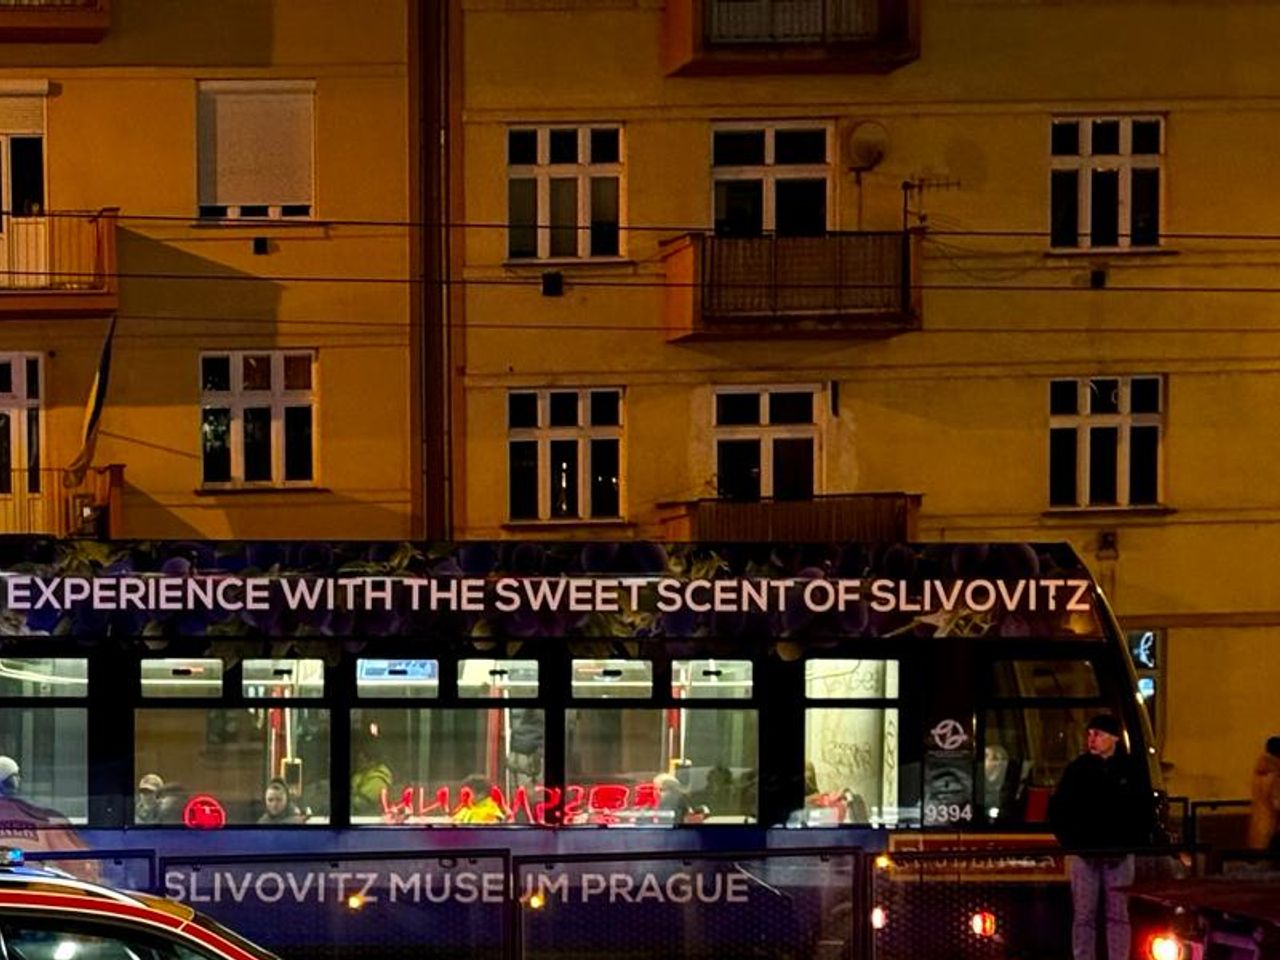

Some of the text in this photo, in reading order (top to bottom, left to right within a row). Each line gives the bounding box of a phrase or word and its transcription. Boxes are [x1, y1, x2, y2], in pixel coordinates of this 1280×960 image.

[7, 577, 270, 611] EXPERIENCE
[280, 577, 393, 611] WITH
[403, 578, 485, 611] THE
[495, 577, 651, 612] SWEET
[656, 578, 794, 612] SCENT
[804, 579, 860, 612] OF
[870, 579, 1091, 612] SLIVOVITZ
[925, 804, 972, 823] 9394
[165, 872, 750, 903] SLIVOVITZ MUSEUM PRAGUE
